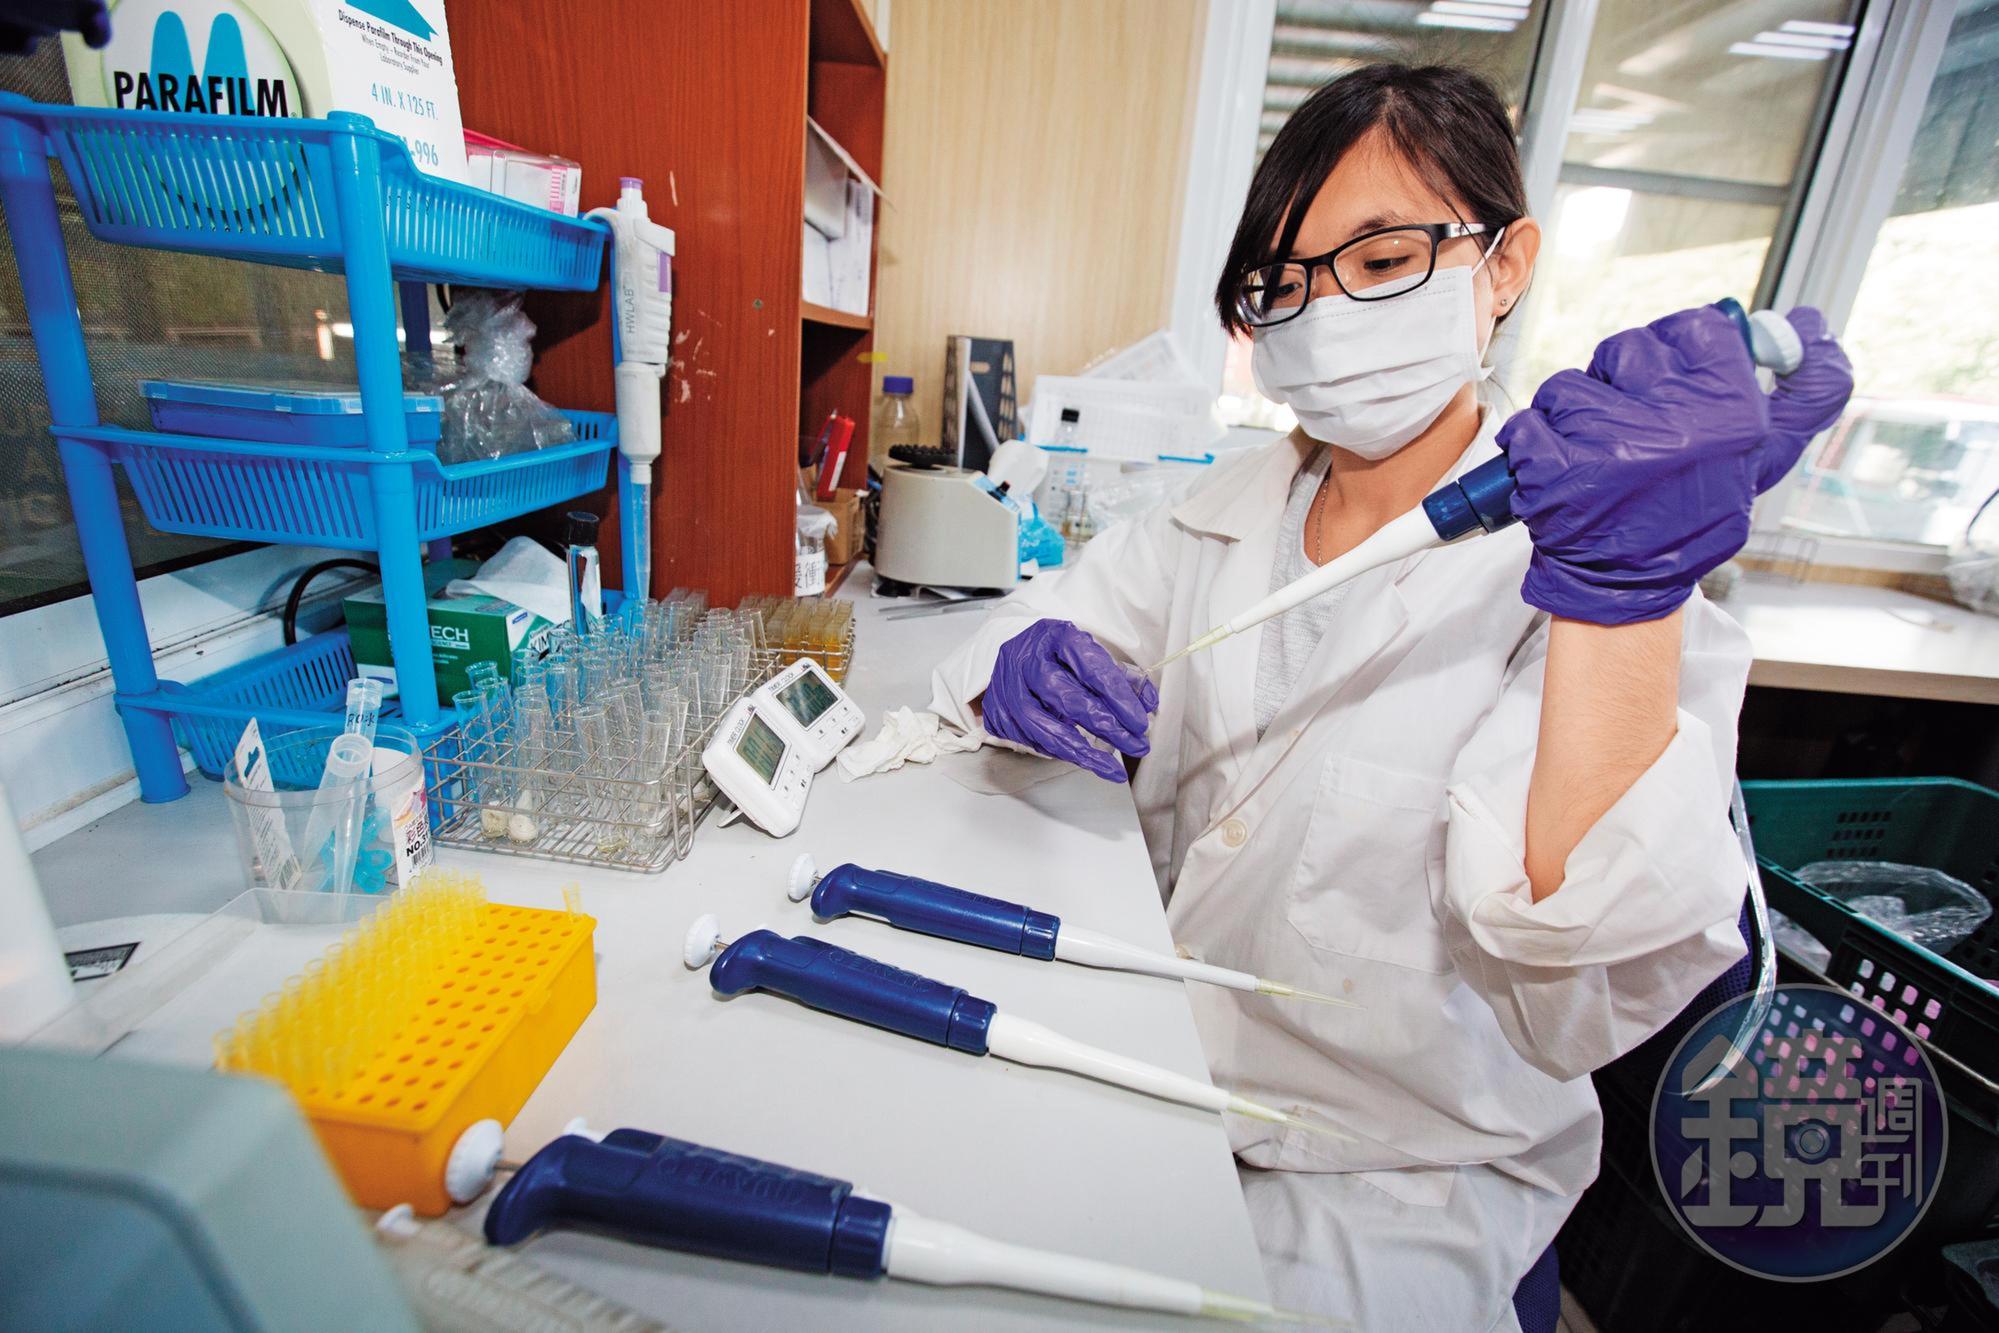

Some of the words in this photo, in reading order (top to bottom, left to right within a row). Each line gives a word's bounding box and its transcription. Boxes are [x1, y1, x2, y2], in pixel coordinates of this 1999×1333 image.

[338, 9, 366, 31] Dispense
[366, 21, 391, 41] Parafilm
[391, 32, 413, 52] Through
[413, 41, 423, 56] This
[423, 47, 443, 66] Opening
[113, 71, 289, 118] PARAFILM
[371, 82, 378, 102] 4
[381, 85, 396, 108] IN.
[398, 89, 405, 111] X
[407, 93, 424, 116] 125
[426, 100, 438, 121] FT.
[402, 136, 439, 167] -996
[624, 287, 635, 334] HWLAB
[431, 625, 469, 642] ECH
